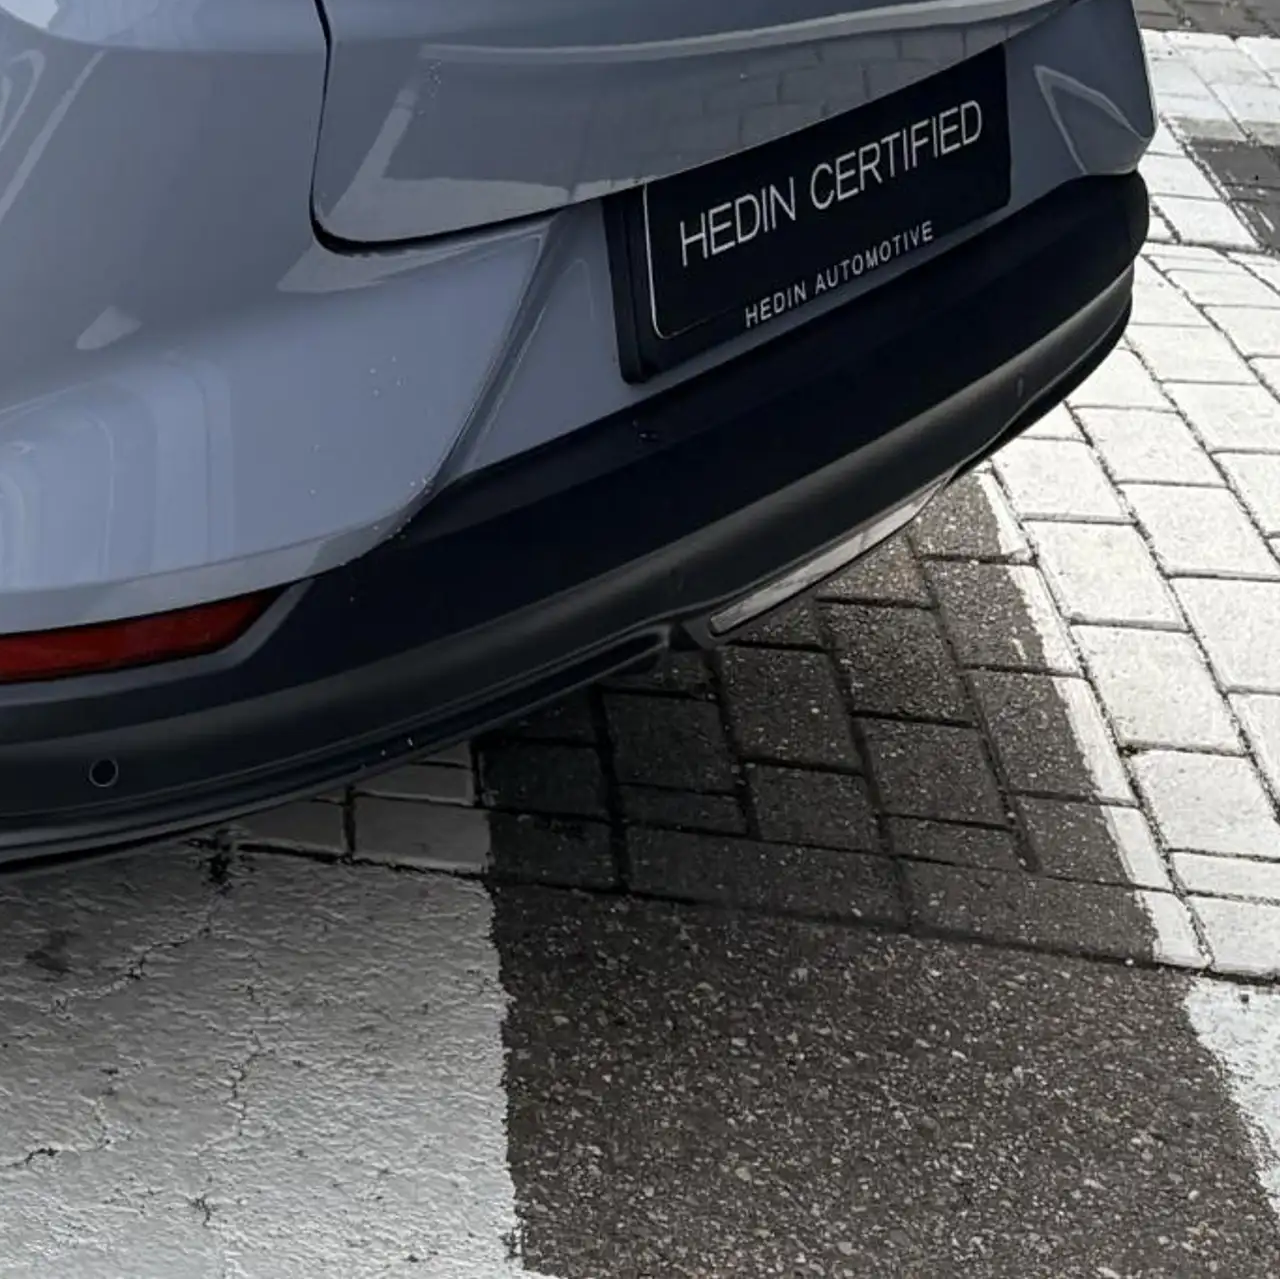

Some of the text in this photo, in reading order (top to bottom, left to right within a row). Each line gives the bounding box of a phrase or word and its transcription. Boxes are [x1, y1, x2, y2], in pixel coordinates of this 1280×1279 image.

[679, 99, 983, 267] HEDIN CERTIFIED
[745, 221, 935, 328] HEDIN AUTOMOTIVE
